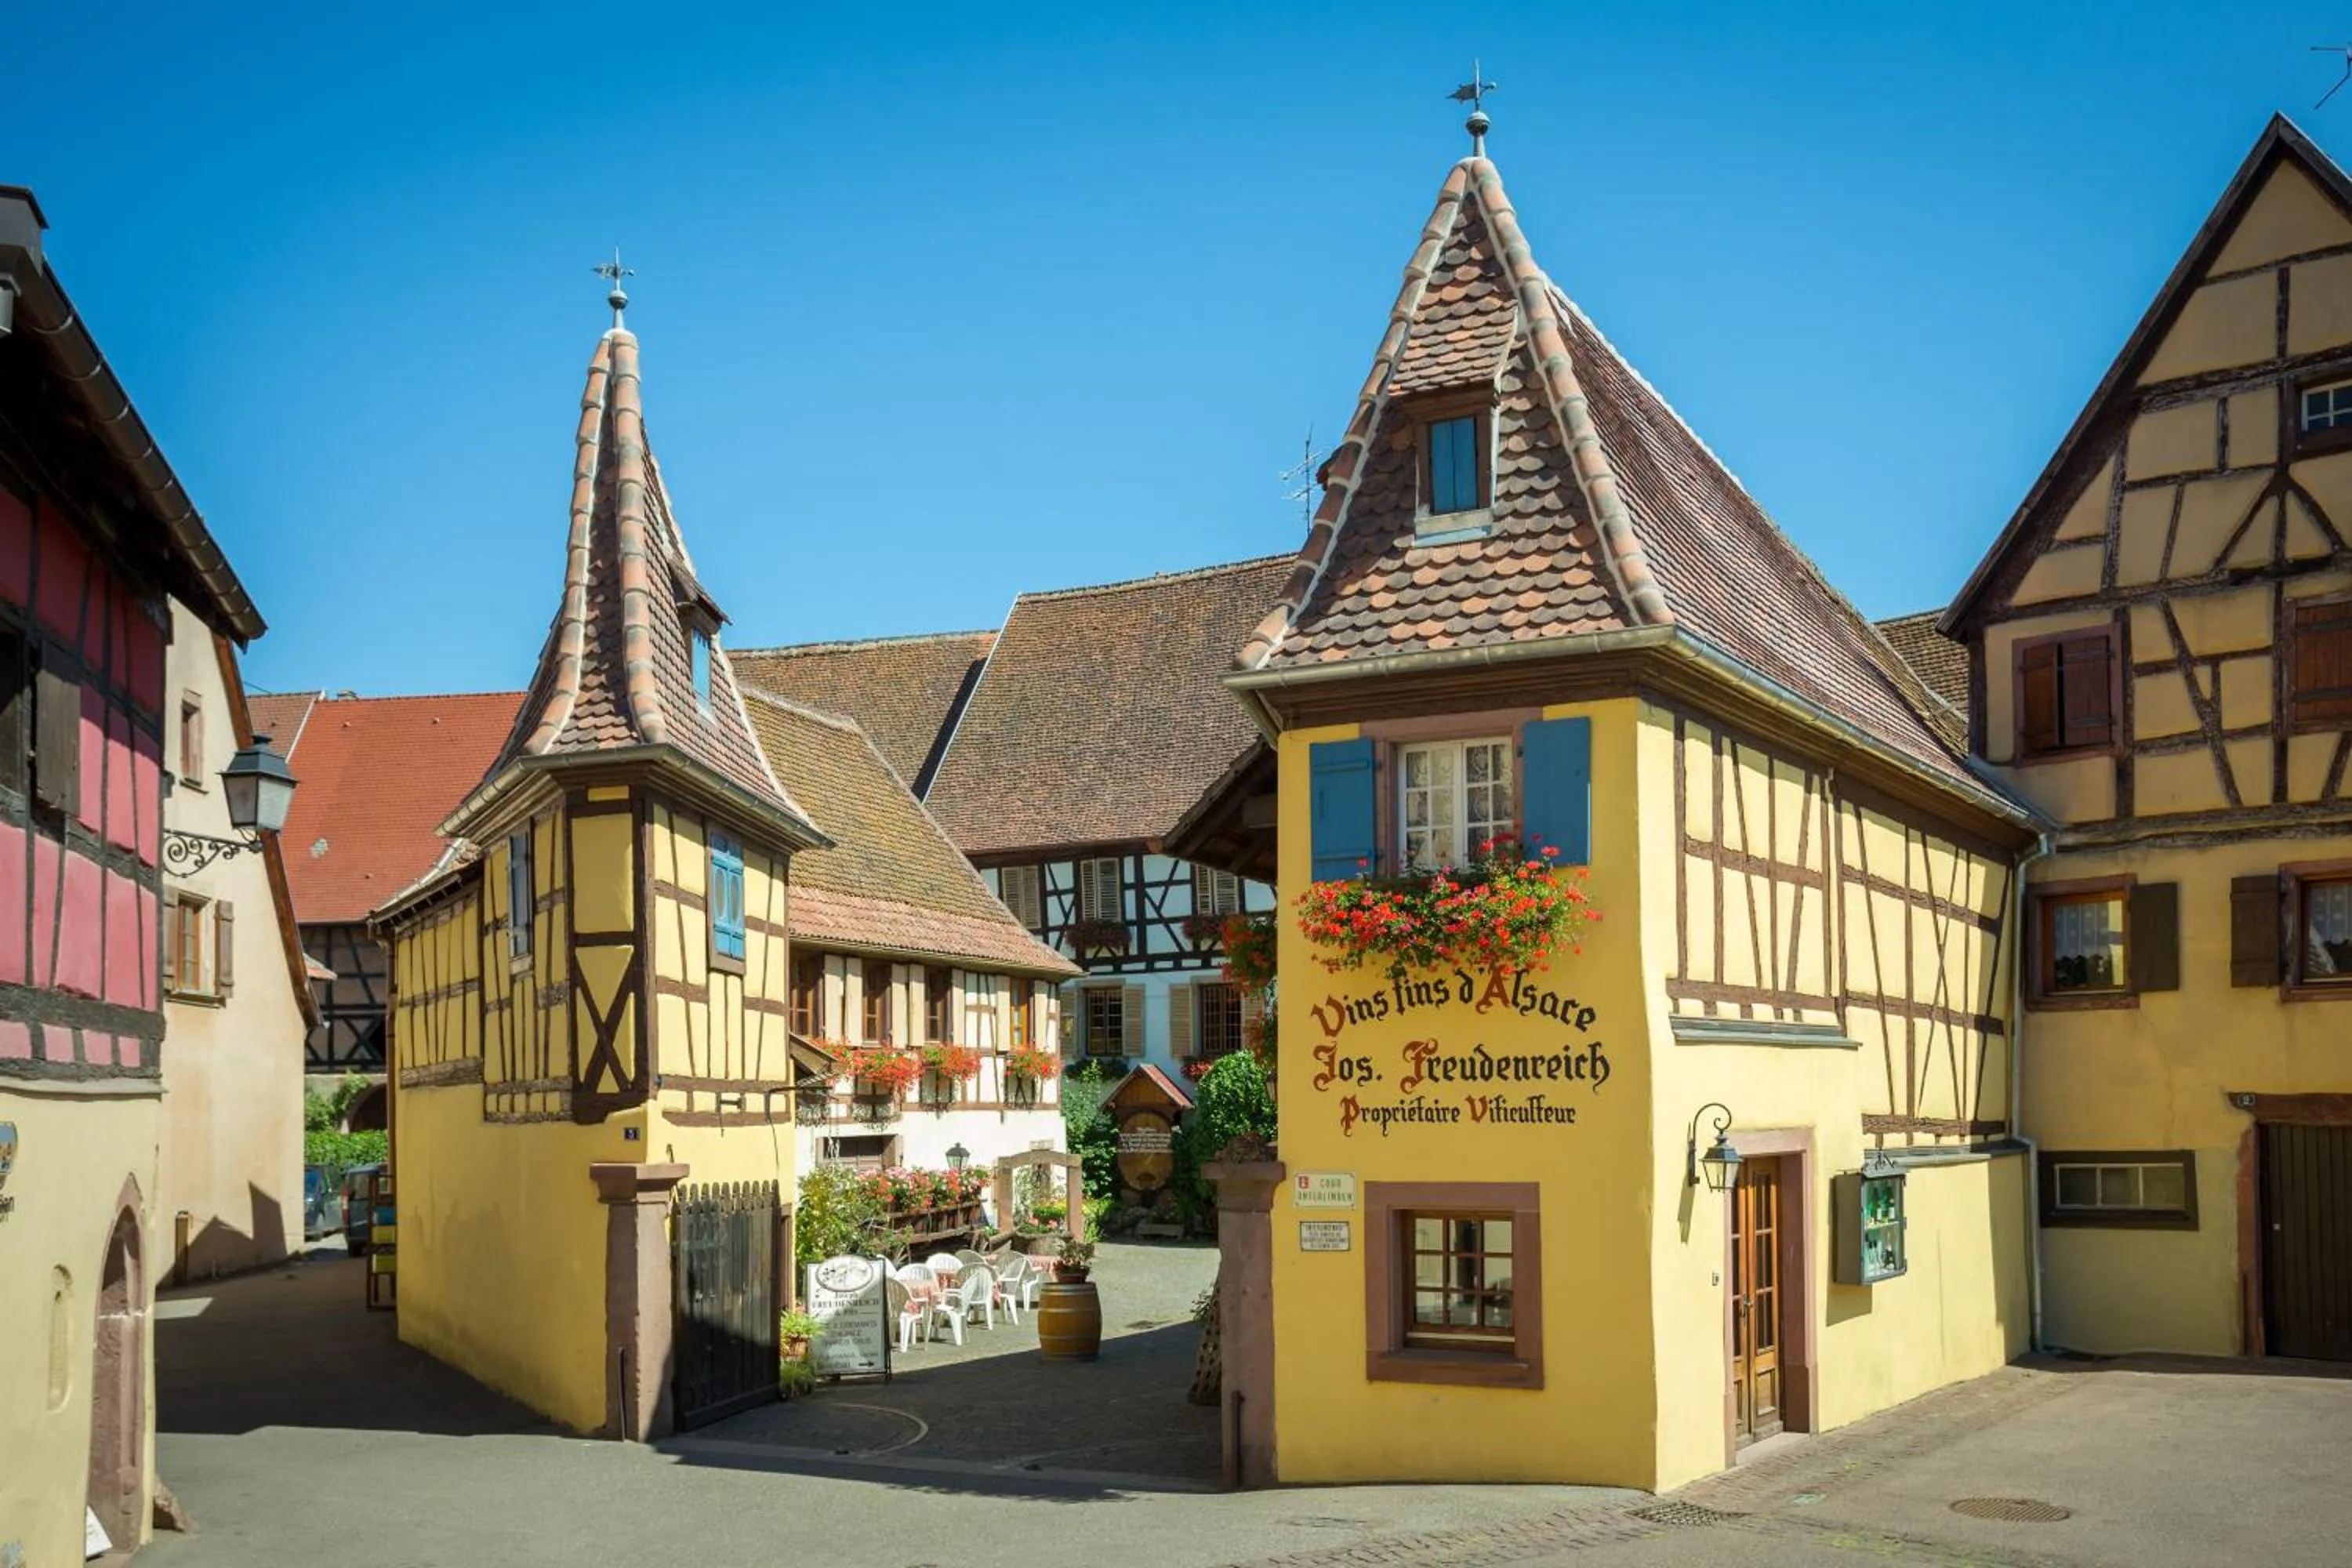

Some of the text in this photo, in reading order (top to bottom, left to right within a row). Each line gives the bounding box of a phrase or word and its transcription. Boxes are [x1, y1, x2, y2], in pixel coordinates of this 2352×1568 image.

[1311, 964, 1596, 1036] Vins fins d'Alsace
[1312, 1037, 1610, 1095] Jos. Freudenreich
[1340, 1093, 1576, 1137] Propriétaire Viticulteur
